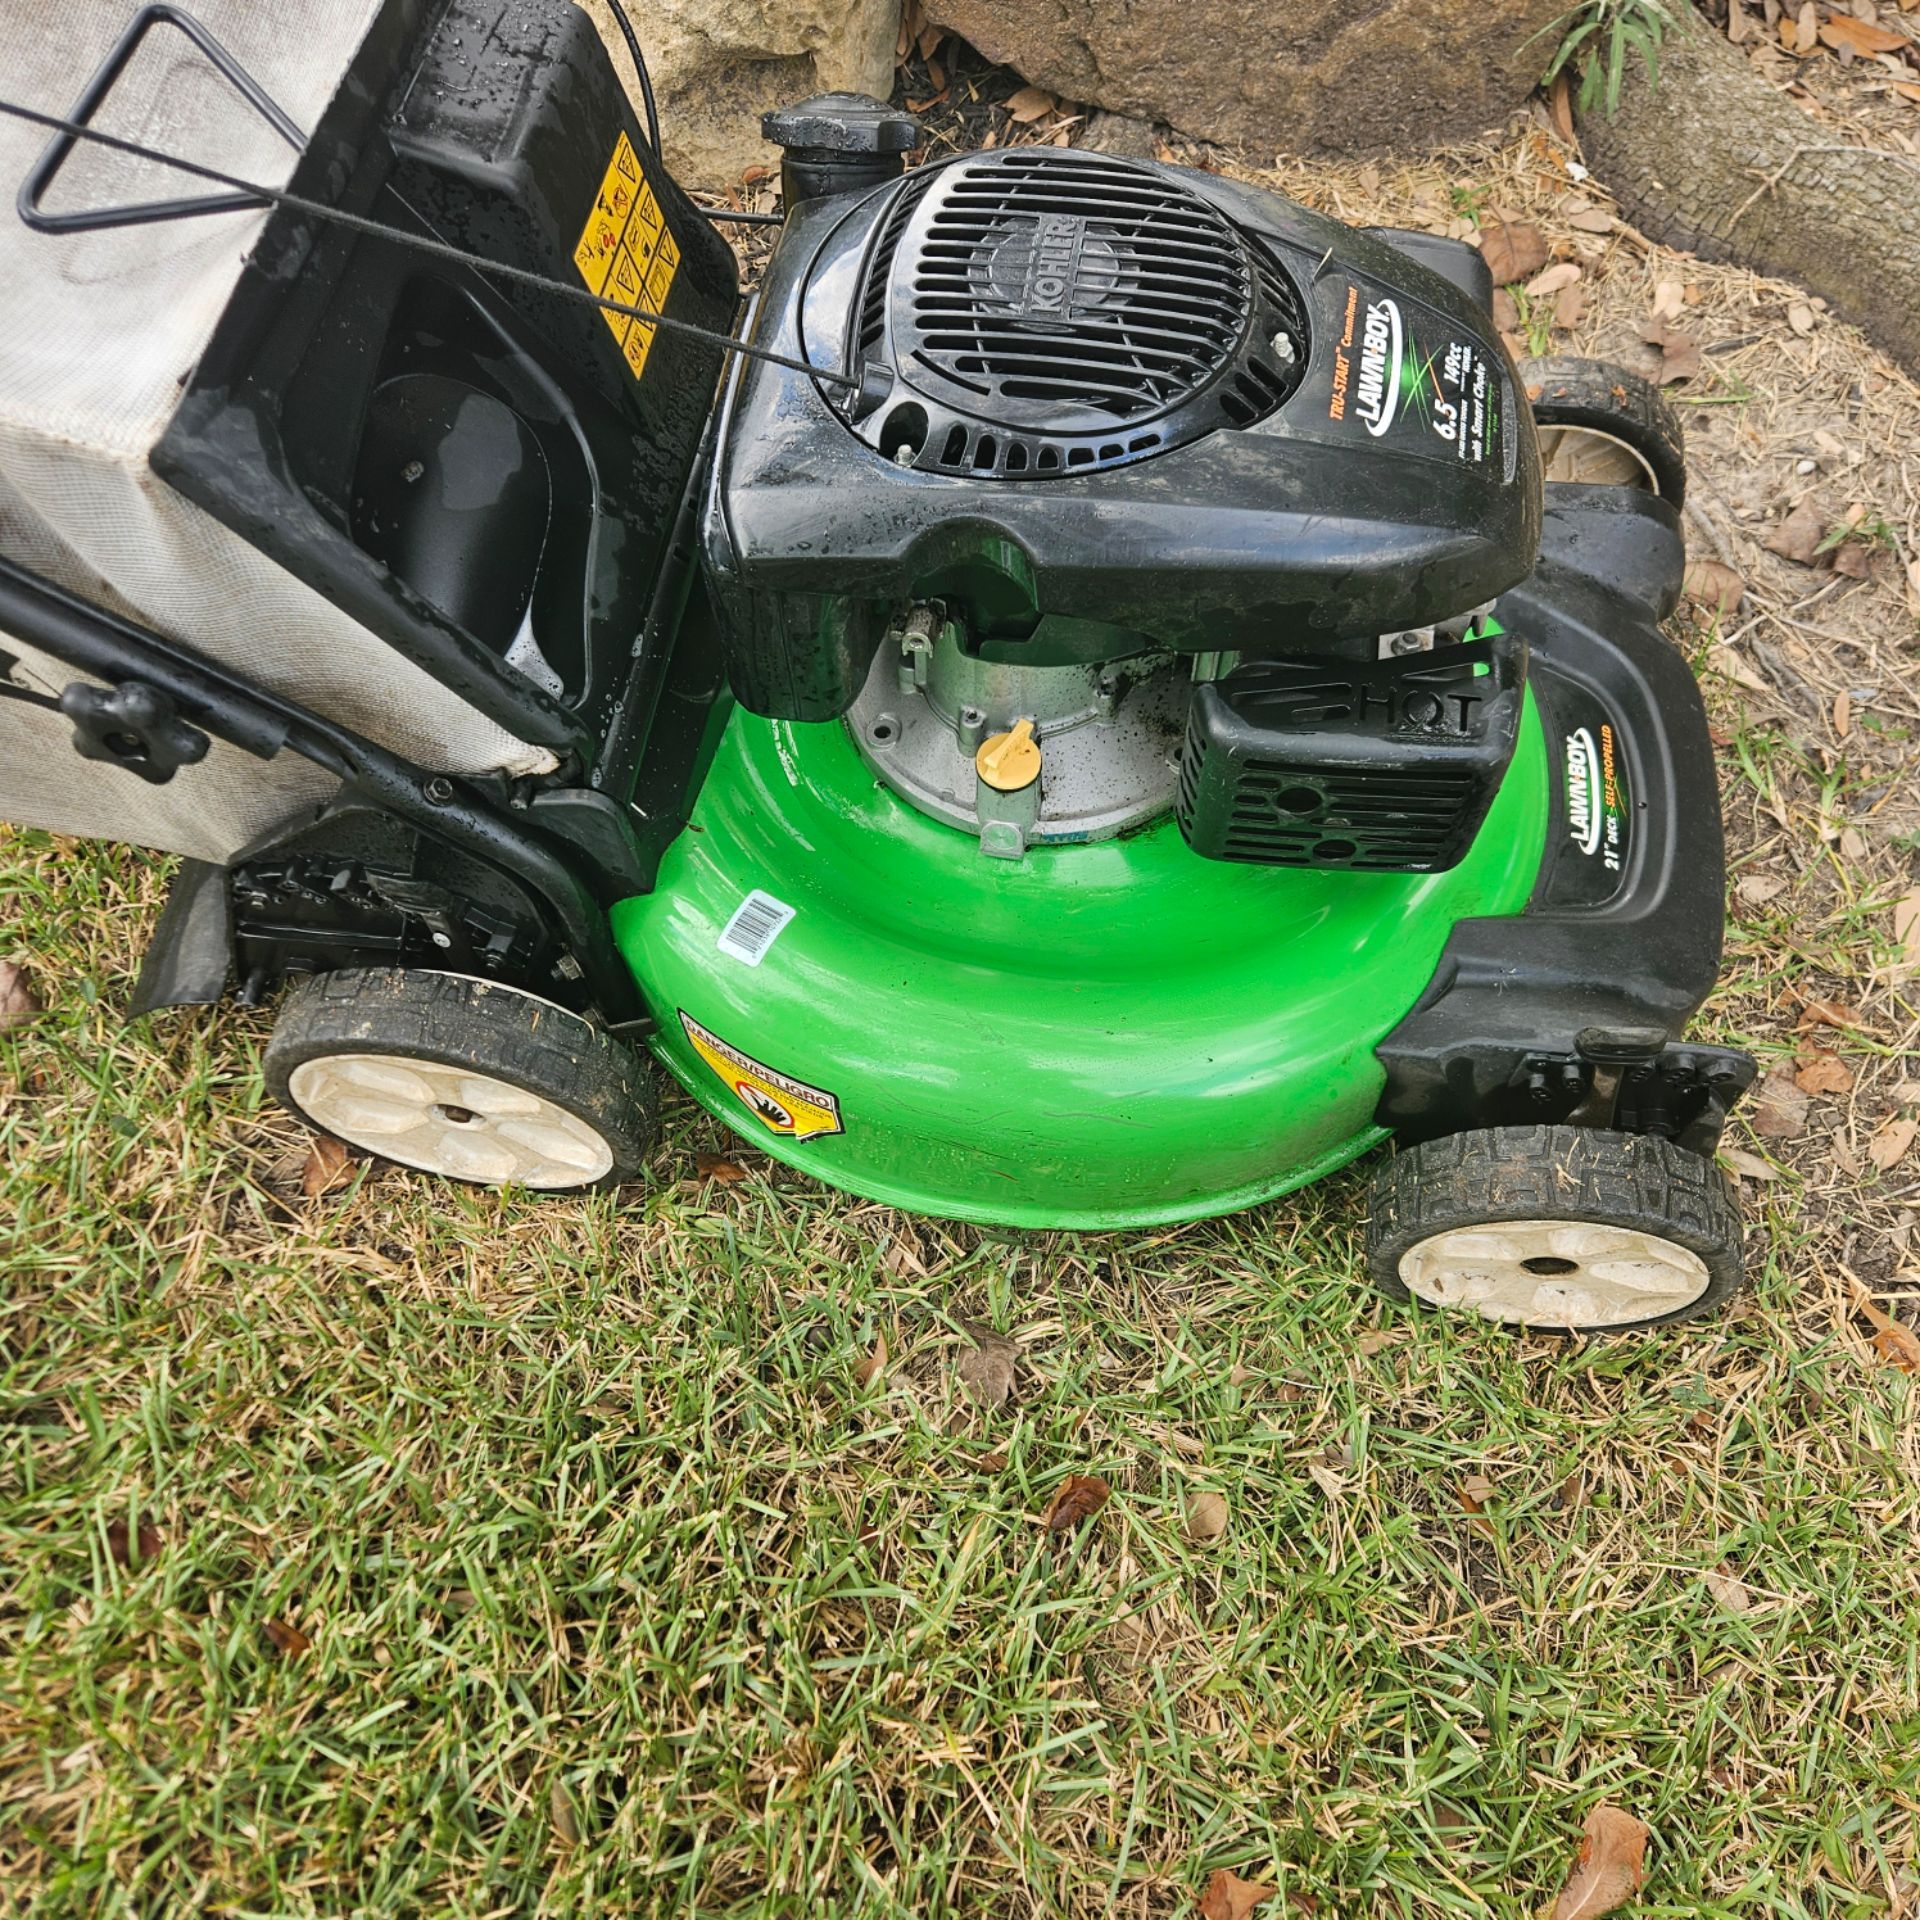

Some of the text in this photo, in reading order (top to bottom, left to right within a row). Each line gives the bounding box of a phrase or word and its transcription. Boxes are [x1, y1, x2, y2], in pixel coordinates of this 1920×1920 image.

[1030, 223, 1076, 312] KOHLER
[1341, 285, 1359, 346] Commitment
[1355, 304, 1391, 423] LAWN-BOY
[1432, 342, 1463, 441] 6.5 149cc
[1471, 361, 1486, 461] with Smart Choke
[1359, 684, 1482, 732] HOT
[1567, 735, 1590, 840] LAWN-BOY
[1601, 725, 1616, 807] SELF-PROPELLED
[1605, 815, 1619, 844] DECK
